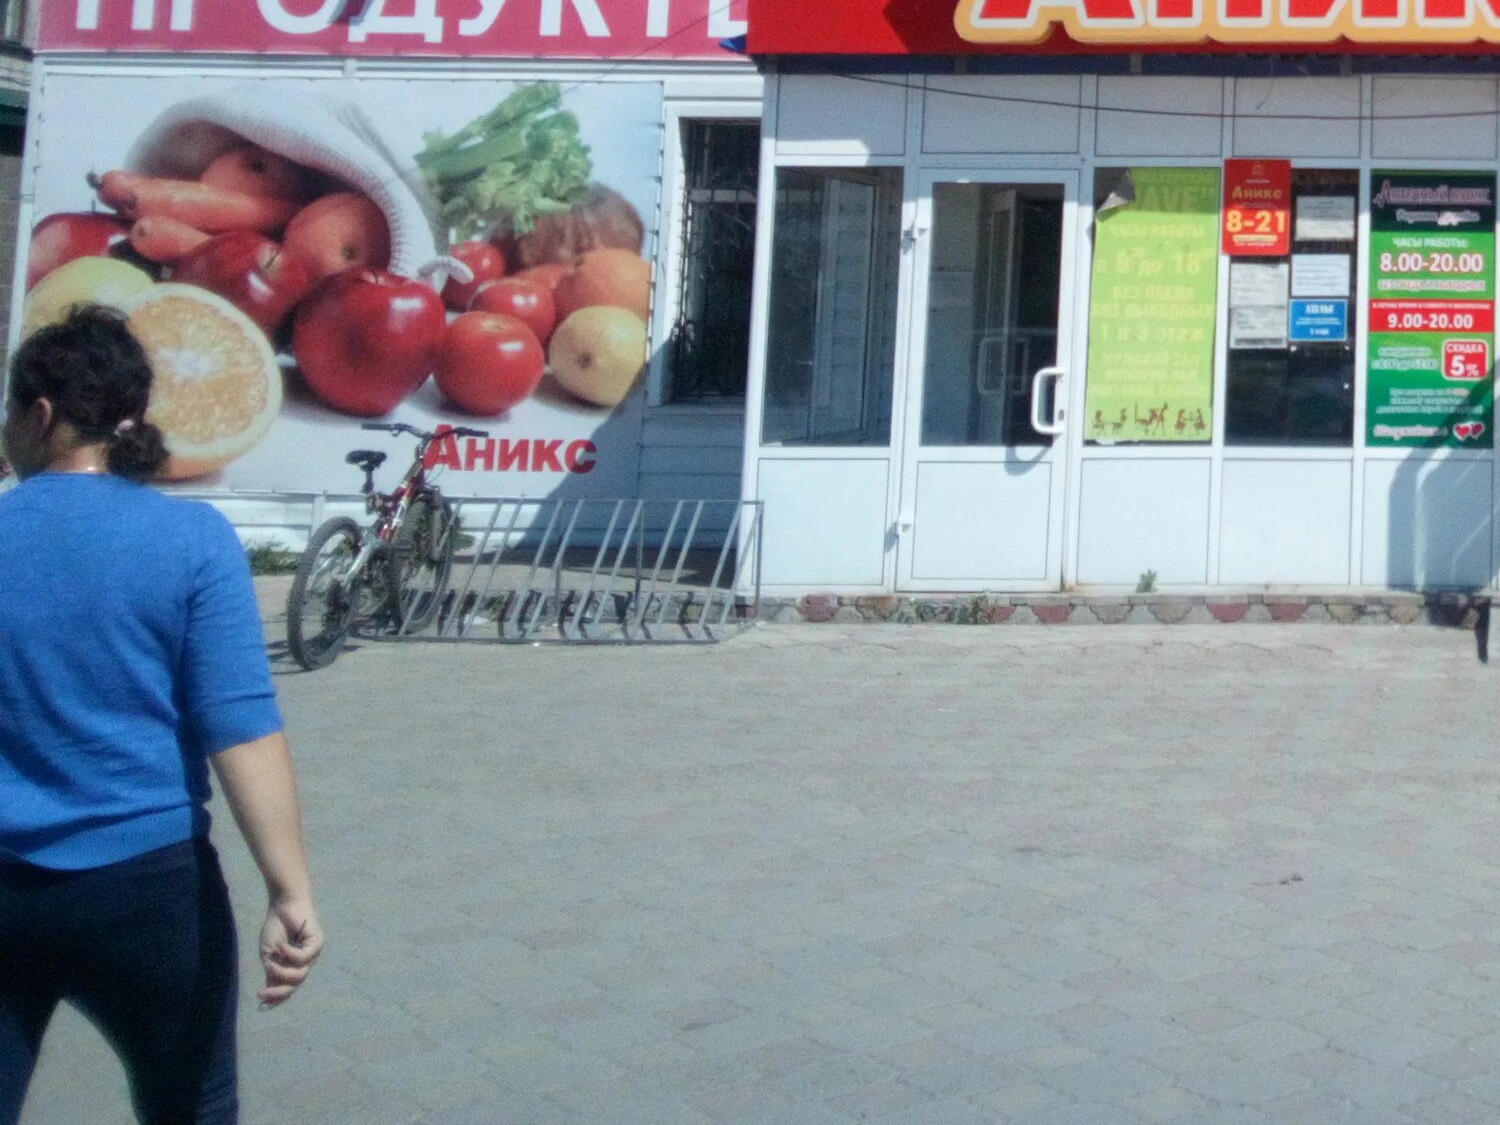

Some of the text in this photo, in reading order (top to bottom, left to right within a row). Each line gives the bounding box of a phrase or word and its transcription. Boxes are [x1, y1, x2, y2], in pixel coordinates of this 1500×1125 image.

[1226, 209, 1286, 233] 8-21
[1380, 252, 1484, 273] 8.00-20.00
[1387, 312, 1474, 330] 9.00-20.00
[422, 424, 598, 475] Аникс
